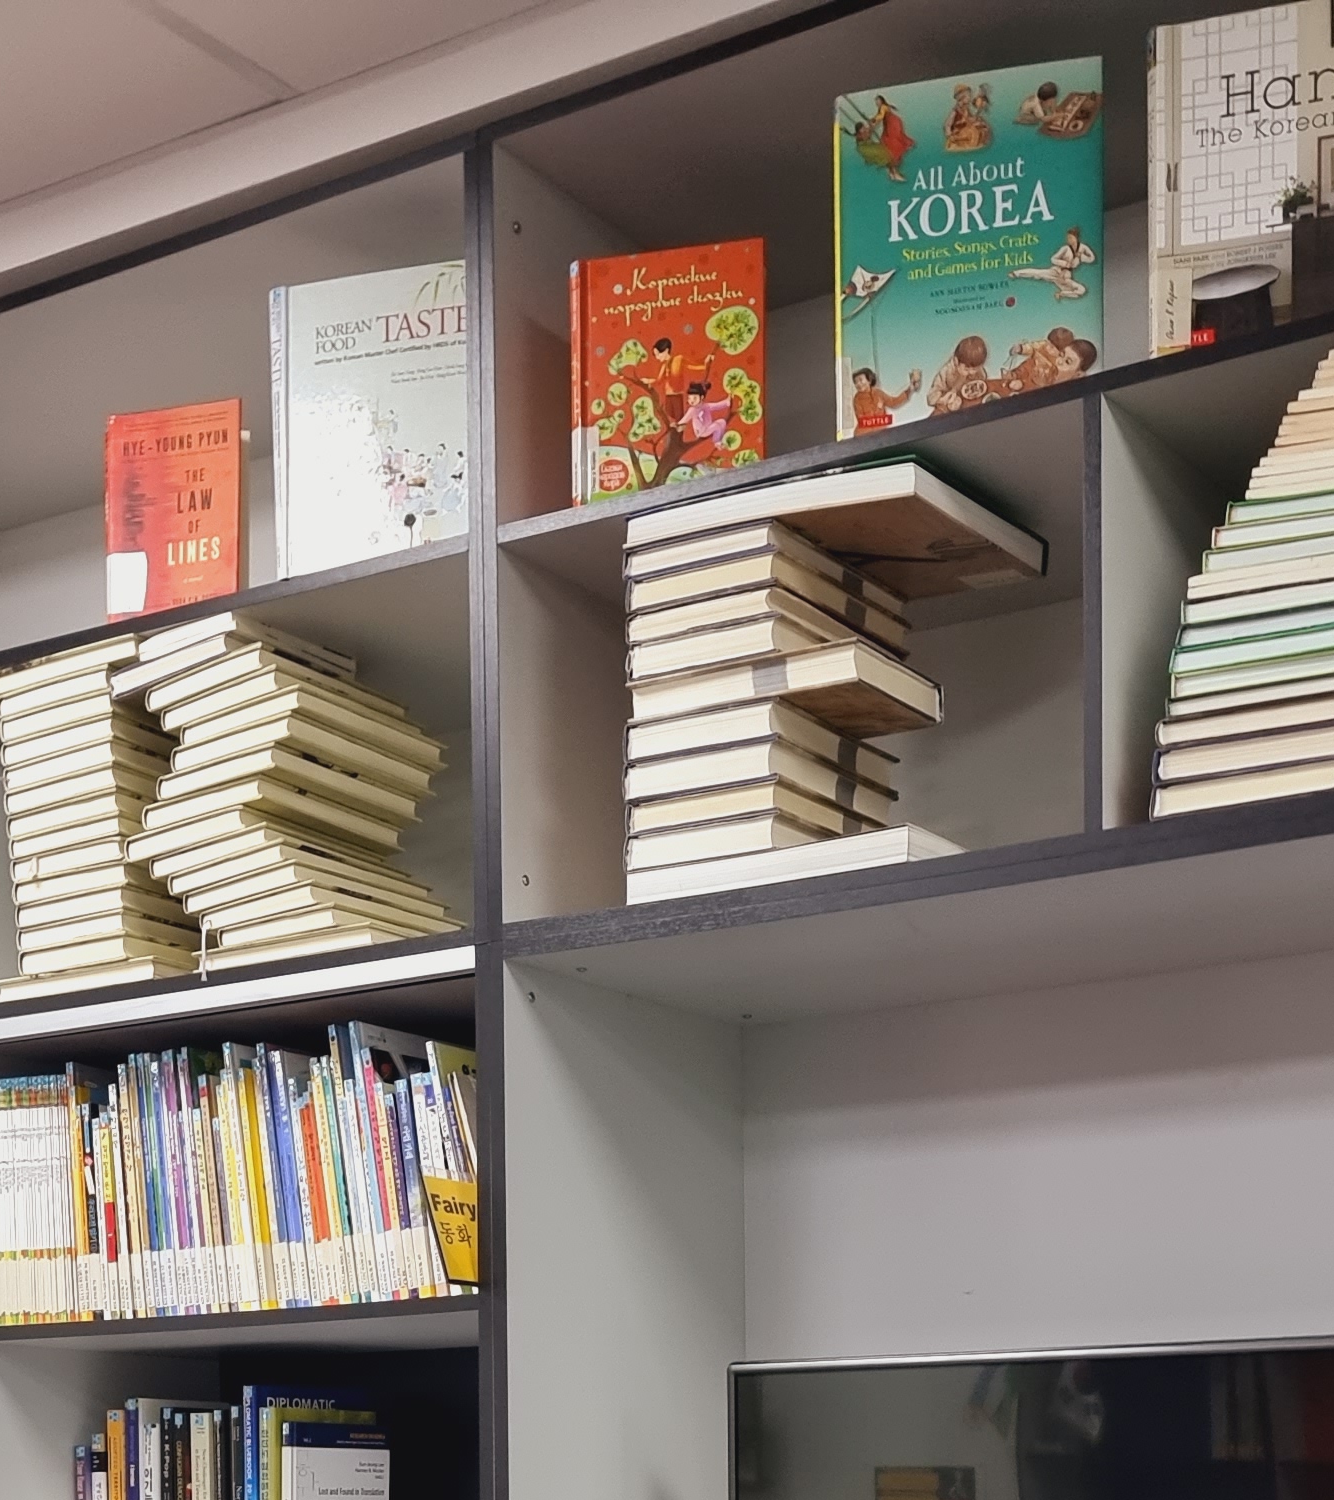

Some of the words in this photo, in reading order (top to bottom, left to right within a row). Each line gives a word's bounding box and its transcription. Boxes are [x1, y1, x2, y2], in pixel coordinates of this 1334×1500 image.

[1196, 127, 1243, 148] The
[913, 165, 944, 191] All
[952, 157, 1025, 187] About
[888, 180, 1055, 242] KOREA
[999, 233, 1039, 249] Crafts
[907, 263, 932, 280] and
[934, 260, 977, 277] Games
[981, 255, 1001, 271] for
[1004, 250, 1033, 267] Kids
[315, 318, 372, 340] KOREAN
[376, 305, 468, 344] TASTE
[315, 336, 357, 354] FOOD
[122, 432, 193, 457] HYE-YOUNG
[198, 427, 229, 448] PYUN
[184, 467, 205, 483] THE
[176, 488, 213, 514] LAW
[188, 519, 202, 534] OF
[167, 536, 221, 567] LINES
[430, 1193, 476, 1222] Fairy
[439, 1221, 472, 1248] 동화
[266, 1397, 336, 1410] DIPLOMATIC
[163, 1443, 171, 1479] K-Pop
